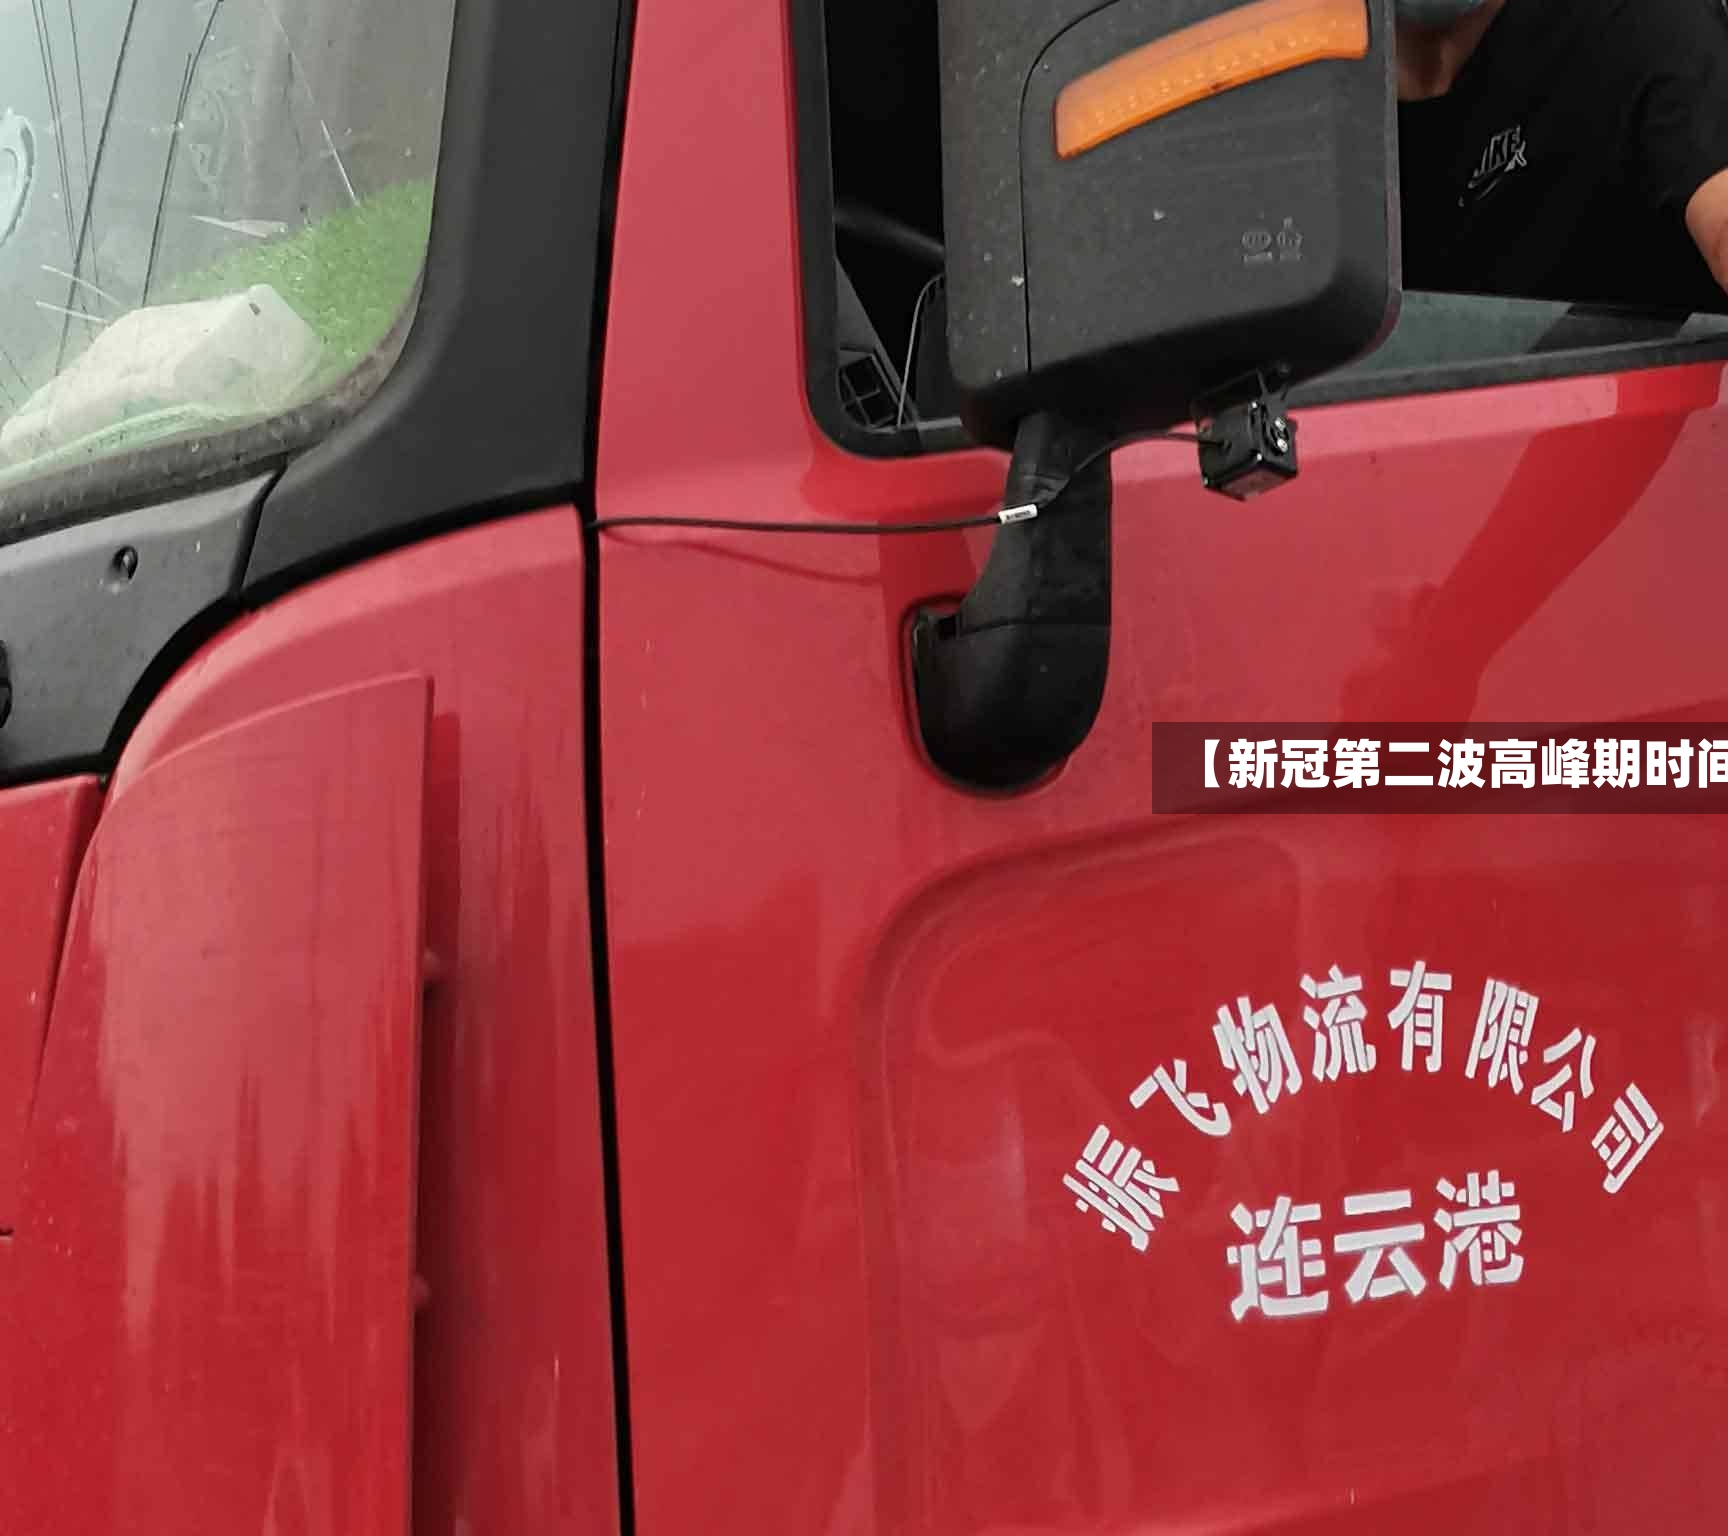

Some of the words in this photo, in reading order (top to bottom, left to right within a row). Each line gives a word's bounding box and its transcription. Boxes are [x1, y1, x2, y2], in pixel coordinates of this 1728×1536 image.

[1062, 959, 1665, 1253] 振飞物流有限公司
[1225, 1169, 1525, 1322] 连云港
